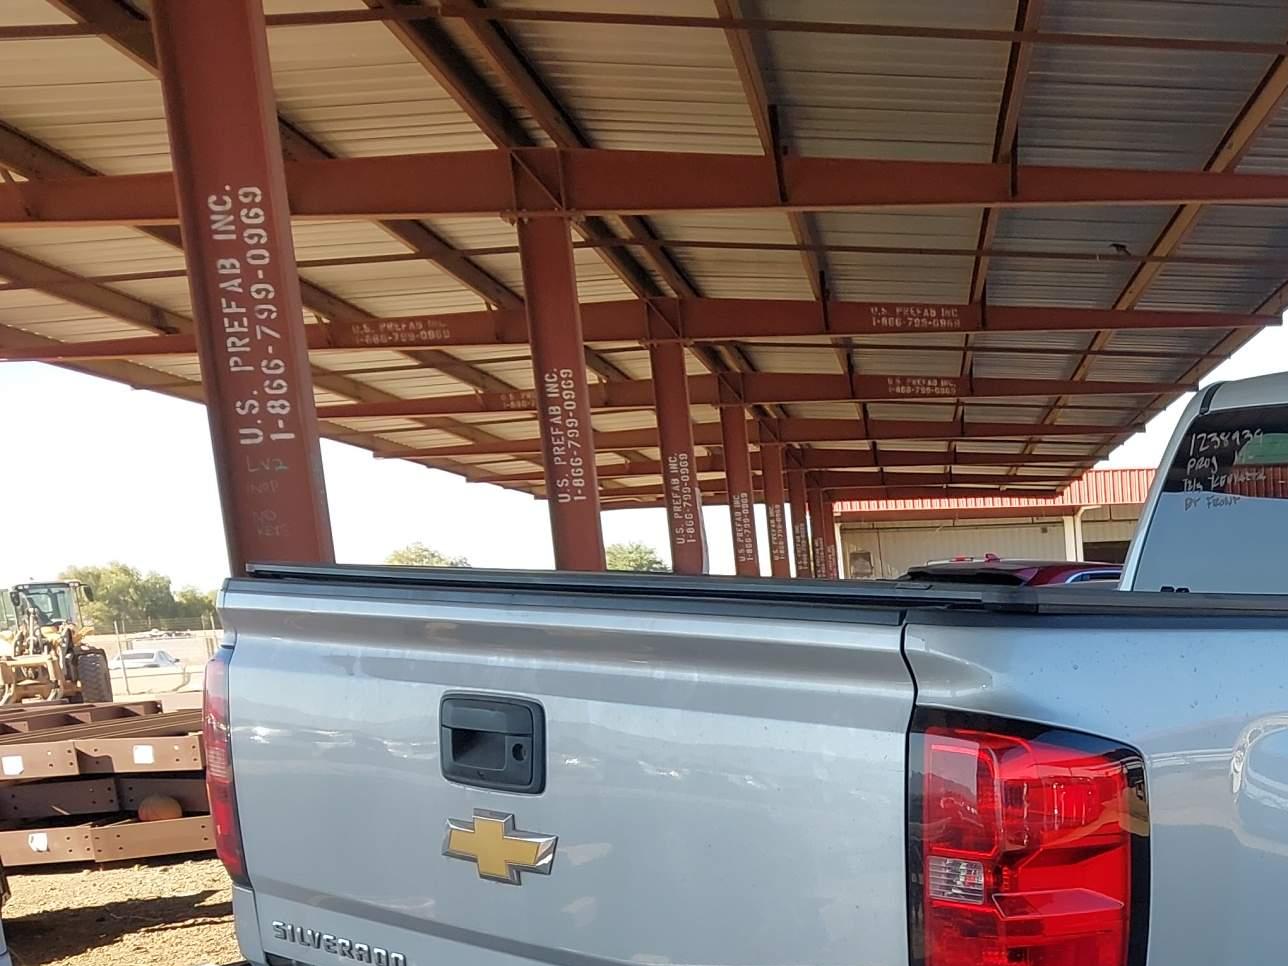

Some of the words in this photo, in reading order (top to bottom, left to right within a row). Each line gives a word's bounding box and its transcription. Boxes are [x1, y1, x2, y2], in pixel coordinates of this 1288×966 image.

[207, 184, 236, 240] INC.
[216, 258, 255, 371] PREFAB
[238, 186, 296, 440] 1-866-799-0969
[544, 367, 560, 398] INC.
[236, 390, 264, 445] U.S.
[548, 405, 568, 465] PREFAB
[560, 368, 587, 501] 1-866-799-0969
[556, 473, 571, 503] U.S.
[668, 452, 679, 473] INC.
[670, 478, 684, 519] PREFAB
[679, 453, 697, 543] 1-866-799-0969
[675, 524, 686, 545] U.S.
